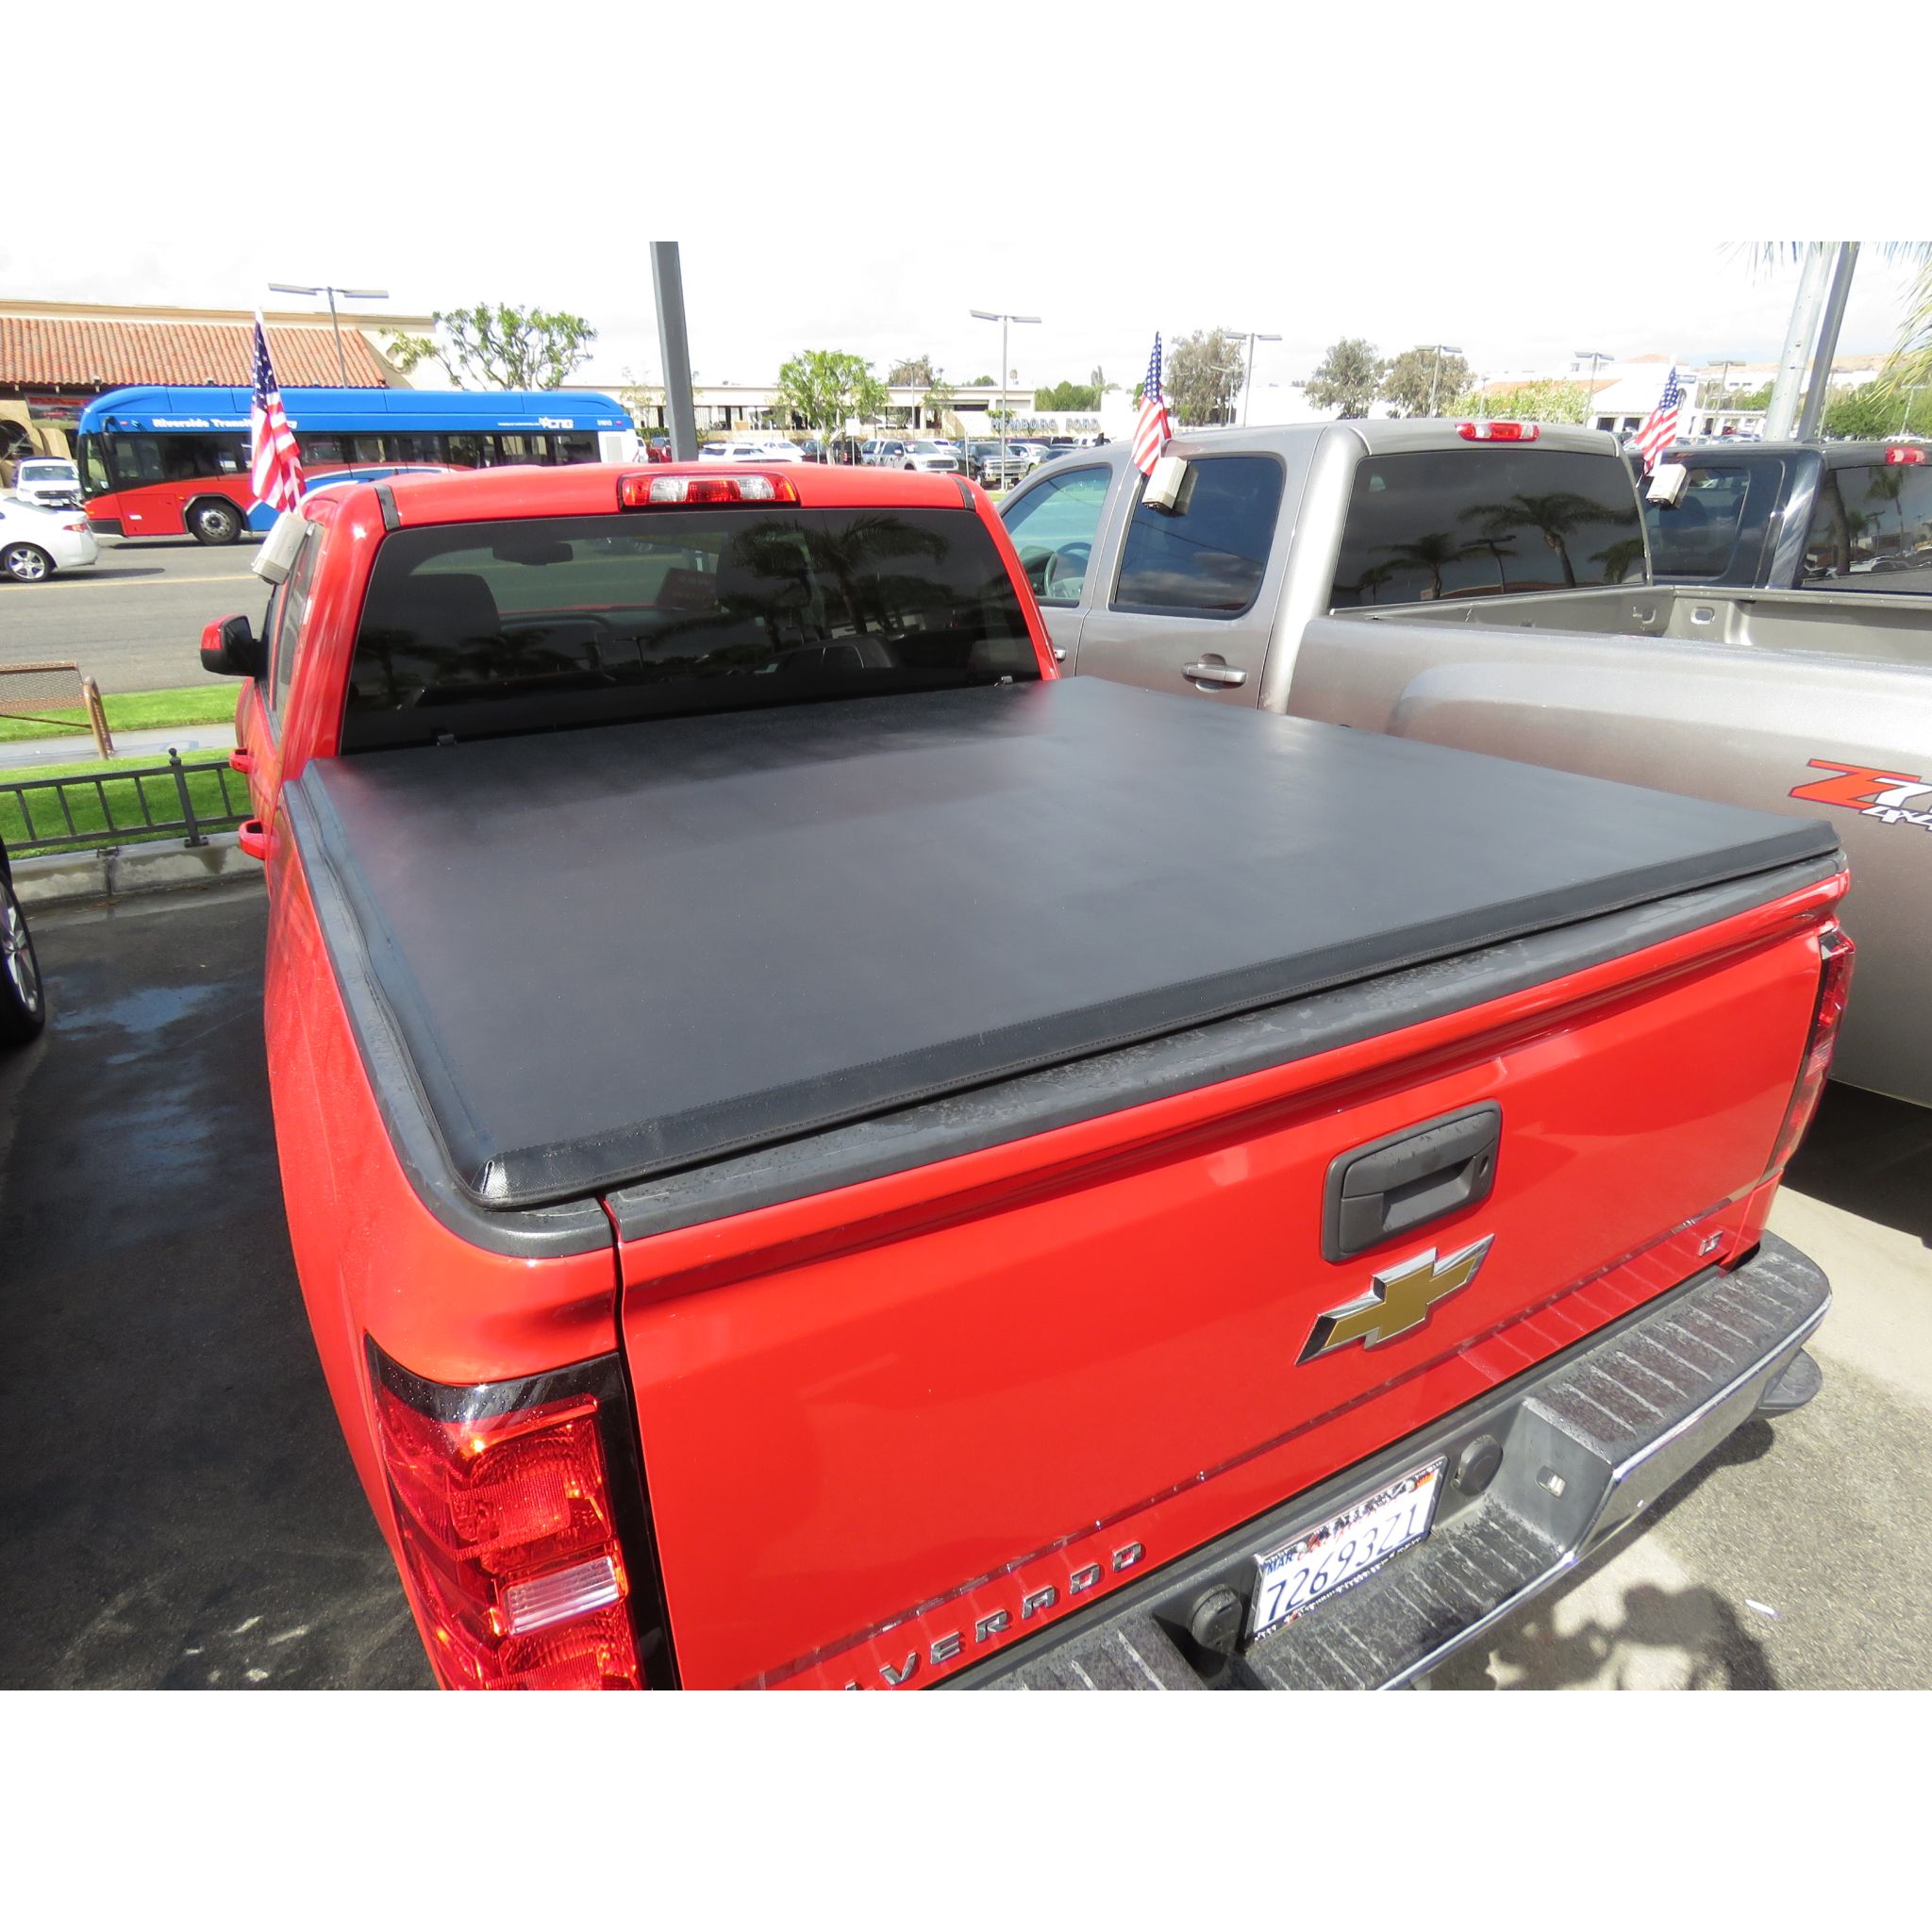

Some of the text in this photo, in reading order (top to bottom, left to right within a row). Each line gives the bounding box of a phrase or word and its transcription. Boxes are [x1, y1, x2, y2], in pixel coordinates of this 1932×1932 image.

[152, 418, 209, 428] Riverside
[1788, 758, 1932, 813] Z7
[1698, 1230, 1724, 1257] LT
[1267, 1553, 1293, 1574] MAR
